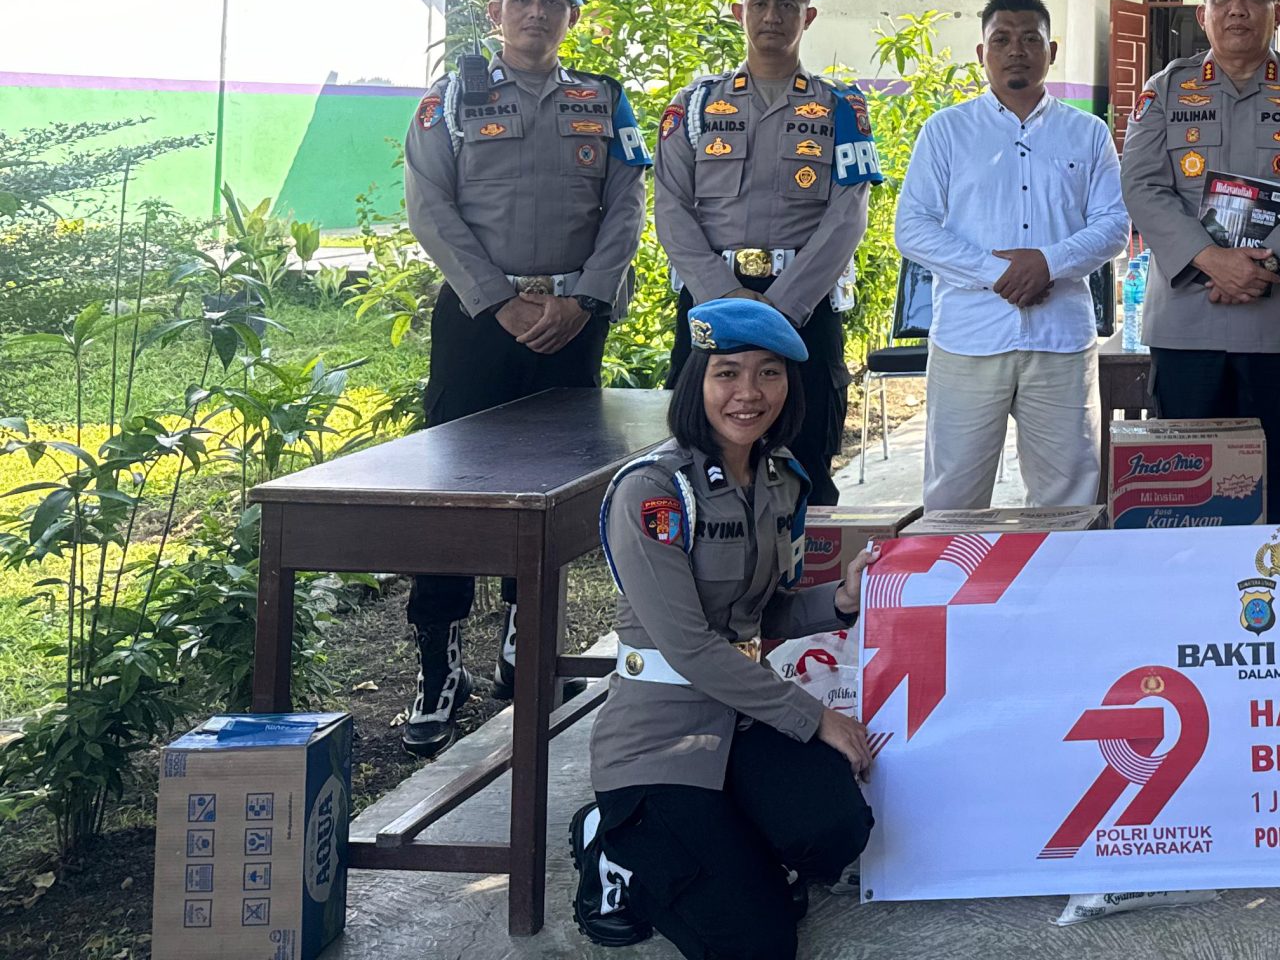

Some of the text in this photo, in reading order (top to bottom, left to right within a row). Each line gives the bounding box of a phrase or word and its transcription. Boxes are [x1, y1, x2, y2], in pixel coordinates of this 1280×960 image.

[465, 103, 608, 118] RISKI POLRI
[1170, 110, 1217, 123] JULIHAN
[703, 120, 835, 138] HALID.S POLRI
[1127, 452, 1204, 477] Indomie
[1146, 514, 1180, 528] Kari
[1177, 642, 1276, 668] BAKTI
[1251, 791, 1261, 813] 1
[315, 789, 336, 887] AQUA
[1096, 825, 1212, 842] POLRI UNTUK
[1096, 840, 1214, 857] MASYARAKAT
